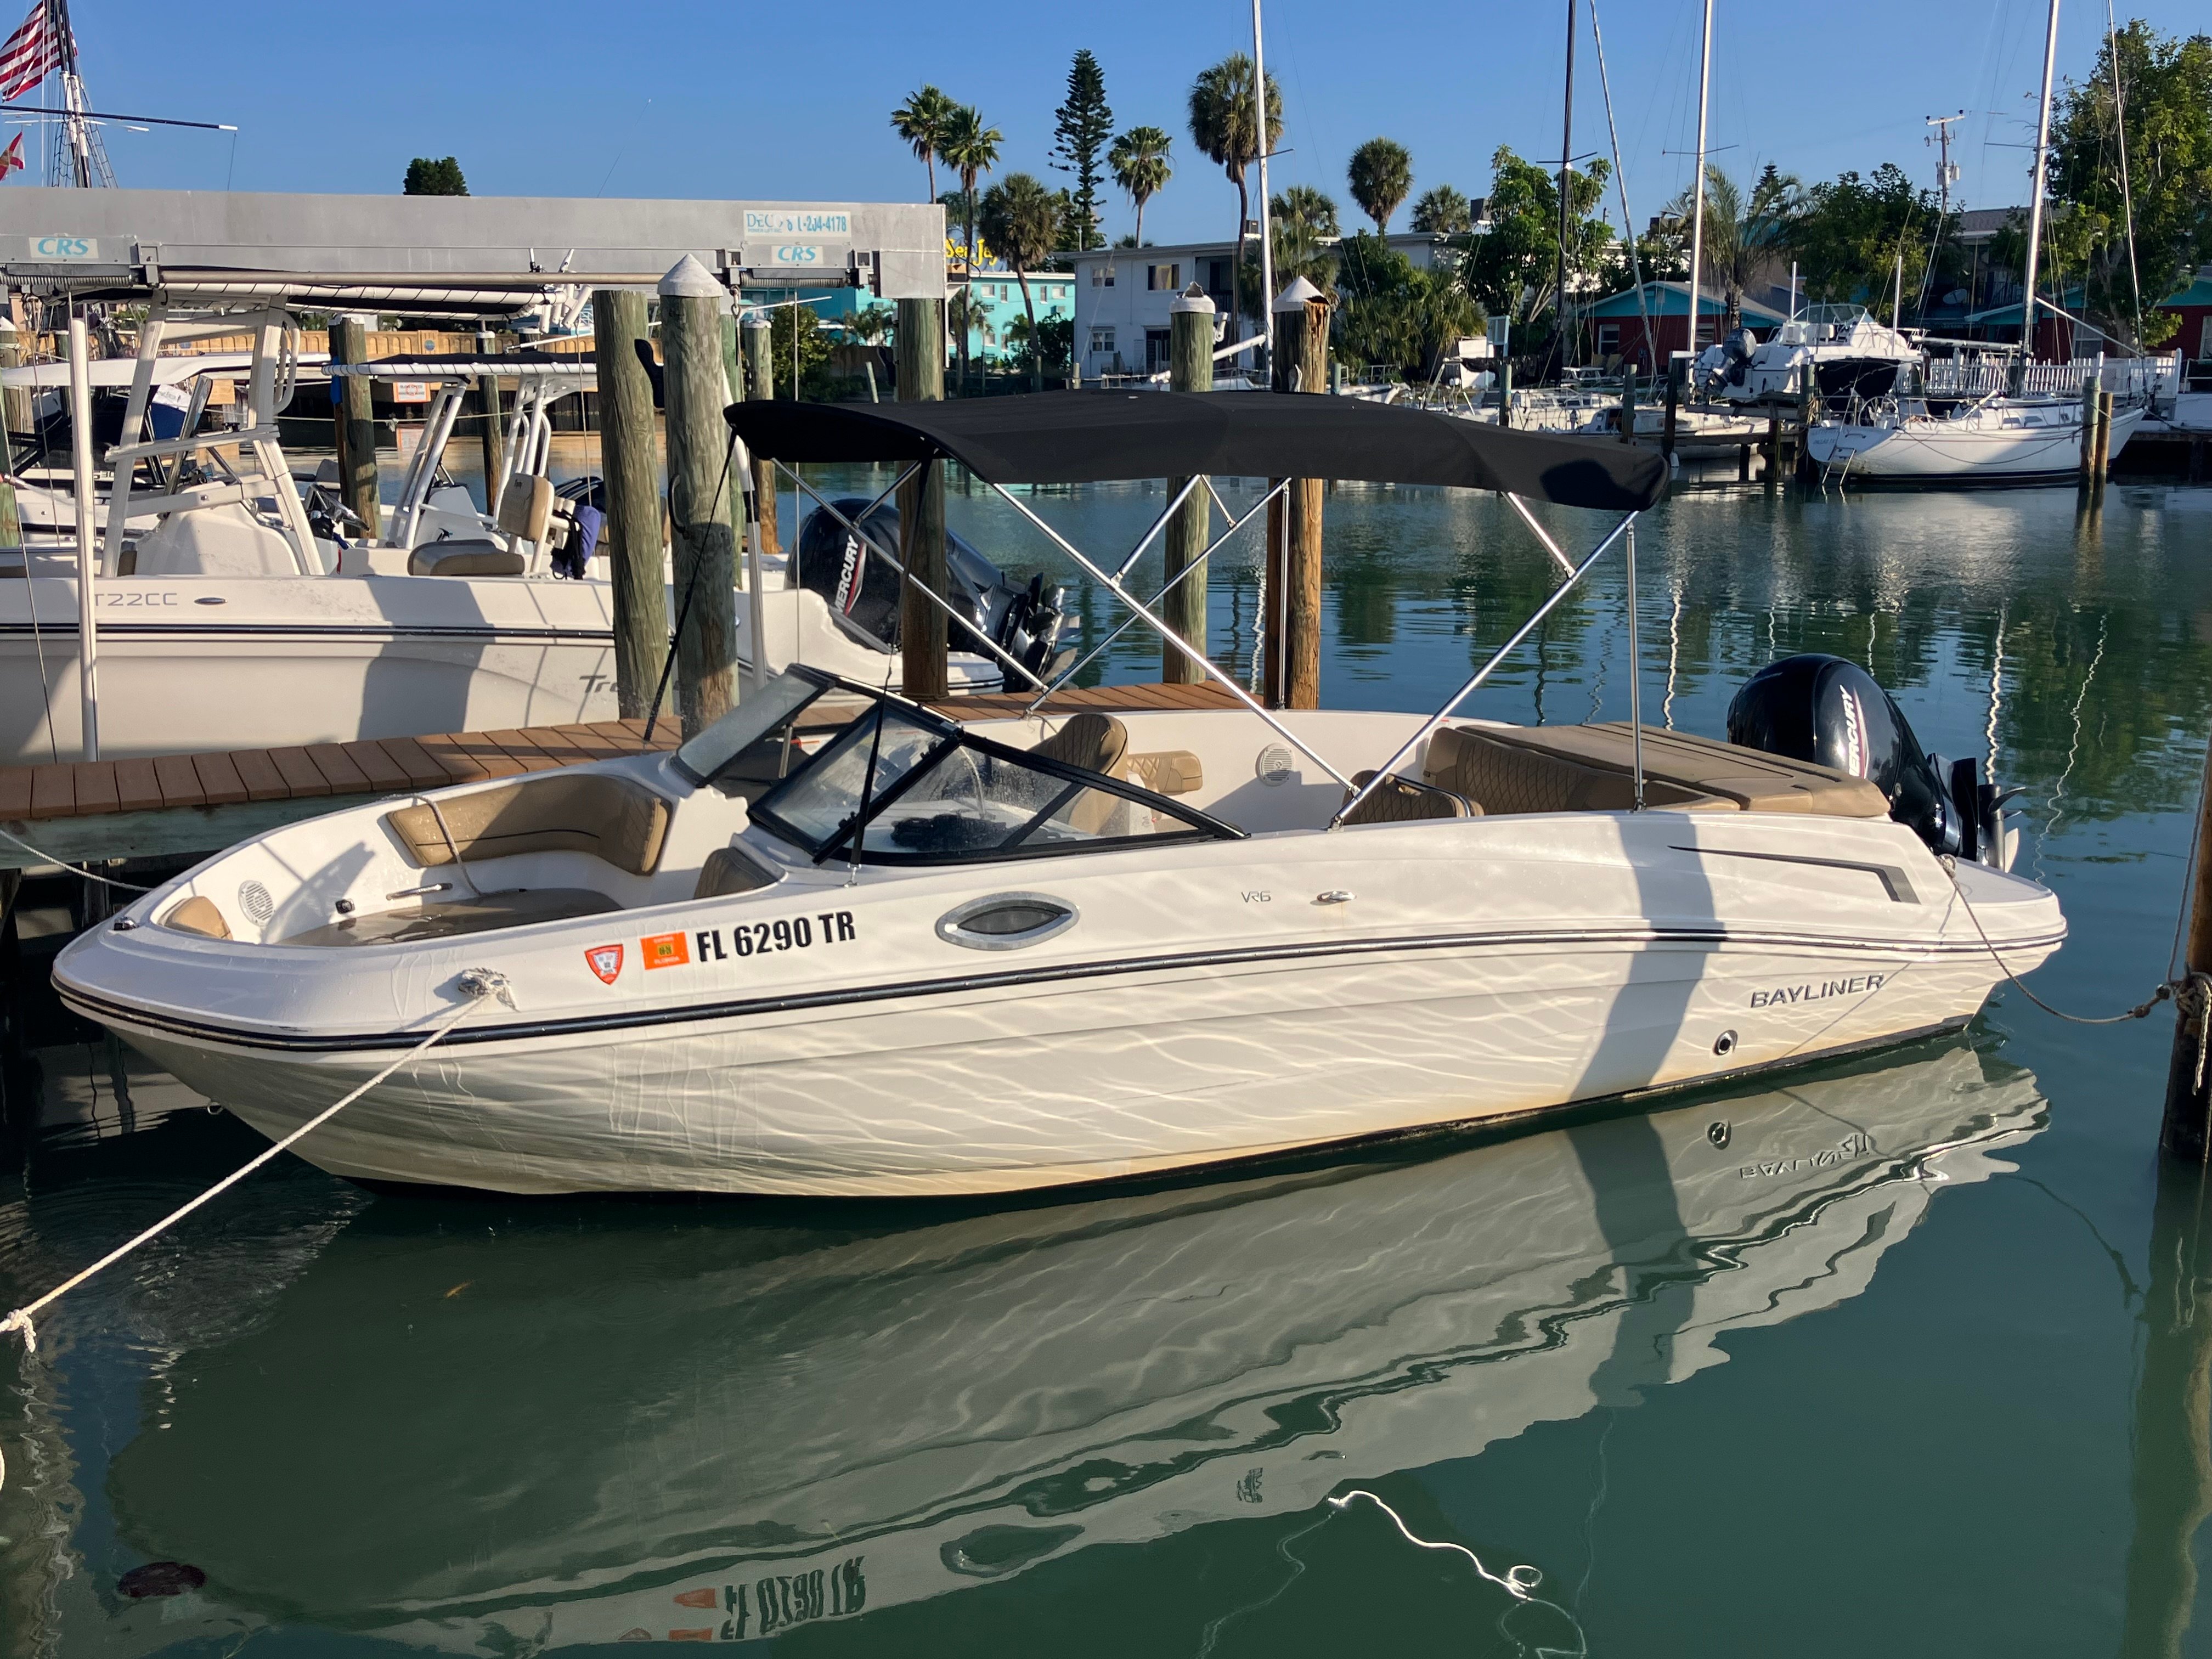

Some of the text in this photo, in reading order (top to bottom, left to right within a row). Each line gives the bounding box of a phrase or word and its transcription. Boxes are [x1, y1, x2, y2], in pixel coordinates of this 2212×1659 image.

[38, 238, 89, 255] CRS
[777, 246, 816, 261] CRS
[1241, 890, 1271, 903] VR6
[696, 911, 856, 962] FL 6290 TR
[1751, 973, 1884, 1008] BAYLINER
